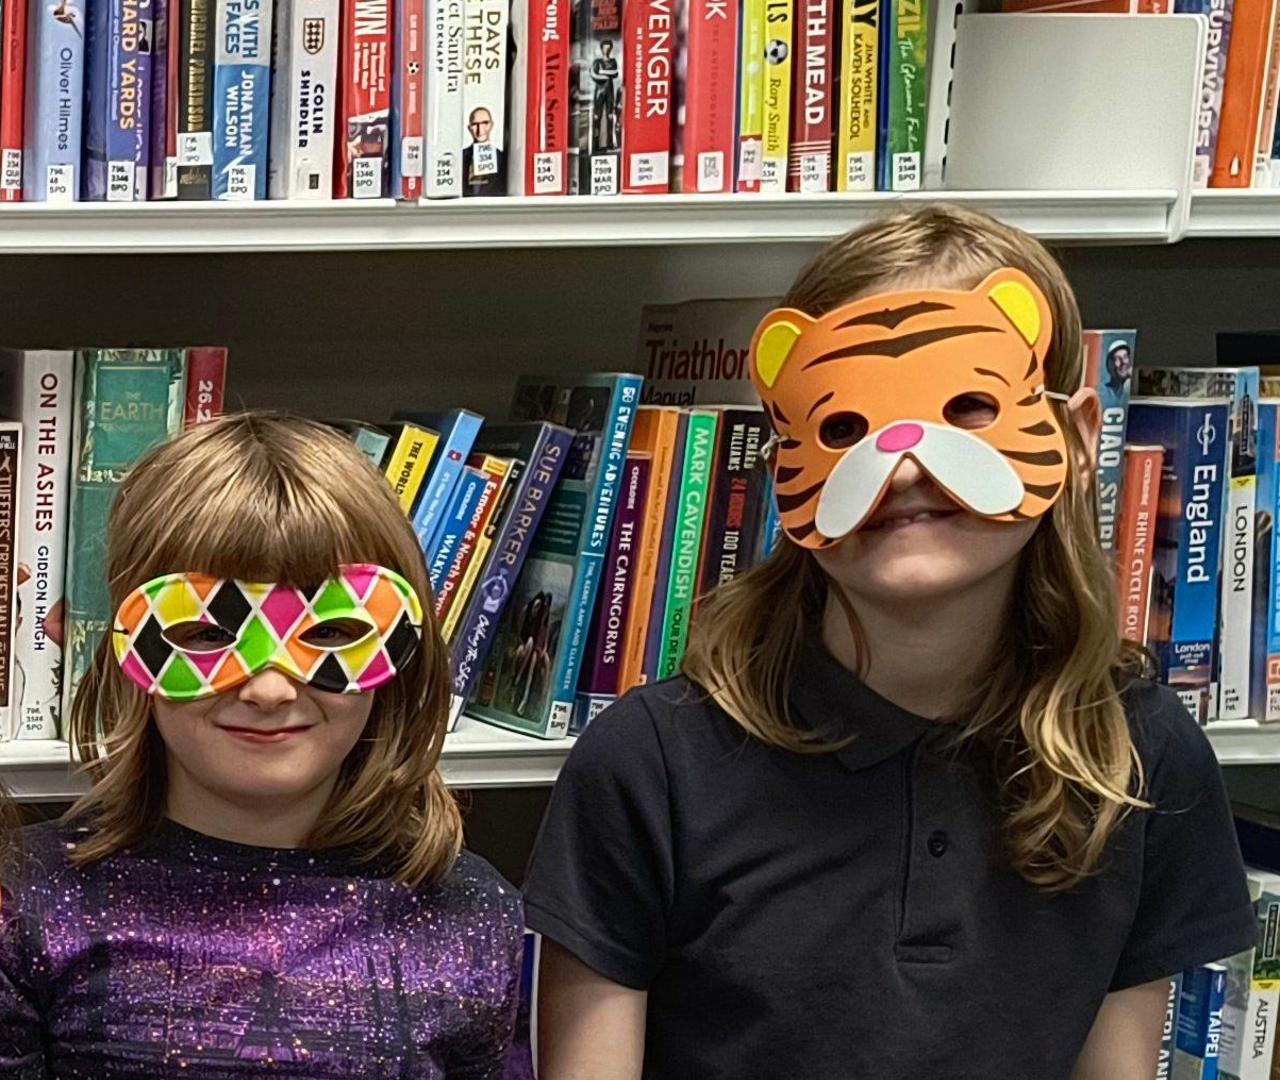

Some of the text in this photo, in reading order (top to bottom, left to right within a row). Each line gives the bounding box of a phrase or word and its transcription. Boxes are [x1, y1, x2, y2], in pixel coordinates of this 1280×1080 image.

[59, 48, 71, 151] Oliver Hilmes
[225, 86, 237, 147] WILSON
[240, 71, 256, 166] JONATHAN
[298, 71, 311, 148] SHINDLER
[312, 84, 325, 134] COLIN
[536, 443, 562, 484] SUE
[34, 372, 59, 652] ON THE ASHES GIDEON HAIGH
[500, 488, 545, 567] BARKER
[674, 427, 710, 599] MARK CAVENDISH
[1186, 464, 1216, 584] England
[1233, 506, 1248, 593] LONDON
[603, 521, 635, 665] THE CAIRNGORMS
